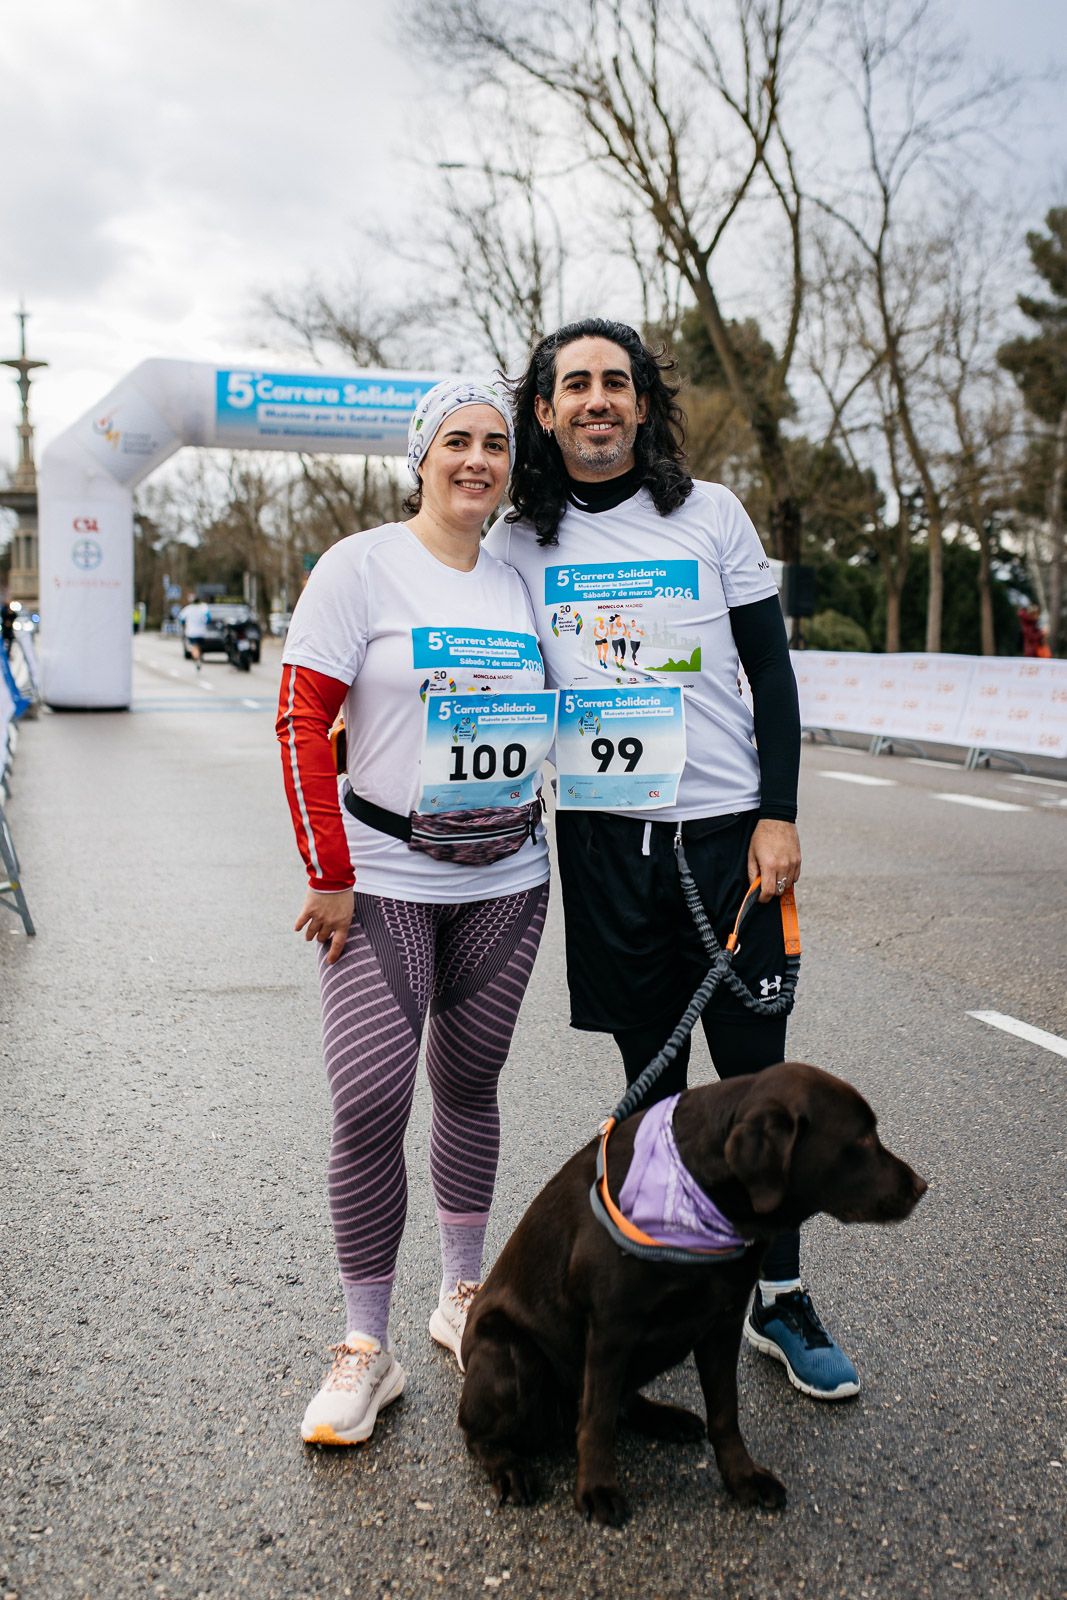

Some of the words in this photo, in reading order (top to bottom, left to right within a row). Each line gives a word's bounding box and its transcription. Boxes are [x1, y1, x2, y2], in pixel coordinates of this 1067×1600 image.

[256, 379, 340, 403] Carrera
[343, 383, 421, 407] Solidari
[572, 571, 615, 581] Carrera
[617, 567, 667, 579] Solidaria
[583, 590, 610, 599] Sábado
[654, 586, 694, 600] 2026
[560, 604, 571, 613] 20
[446, 635, 486, 646] Carrera
[488, 637, 526, 649] Solidaria
[459, 657, 485, 666] Sábado
[492, 659, 500, 667] de
[434, 670, 447, 680] 20
[453, 704, 490, 714] Carrera
[492, 702, 536, 713] Solidaria
[577, 698, 613, 708] Carrera
[615, 695, 661, 707] Solidaria
[591, 737, 643, 772] 99
[449, 743, 527, 781] 100
